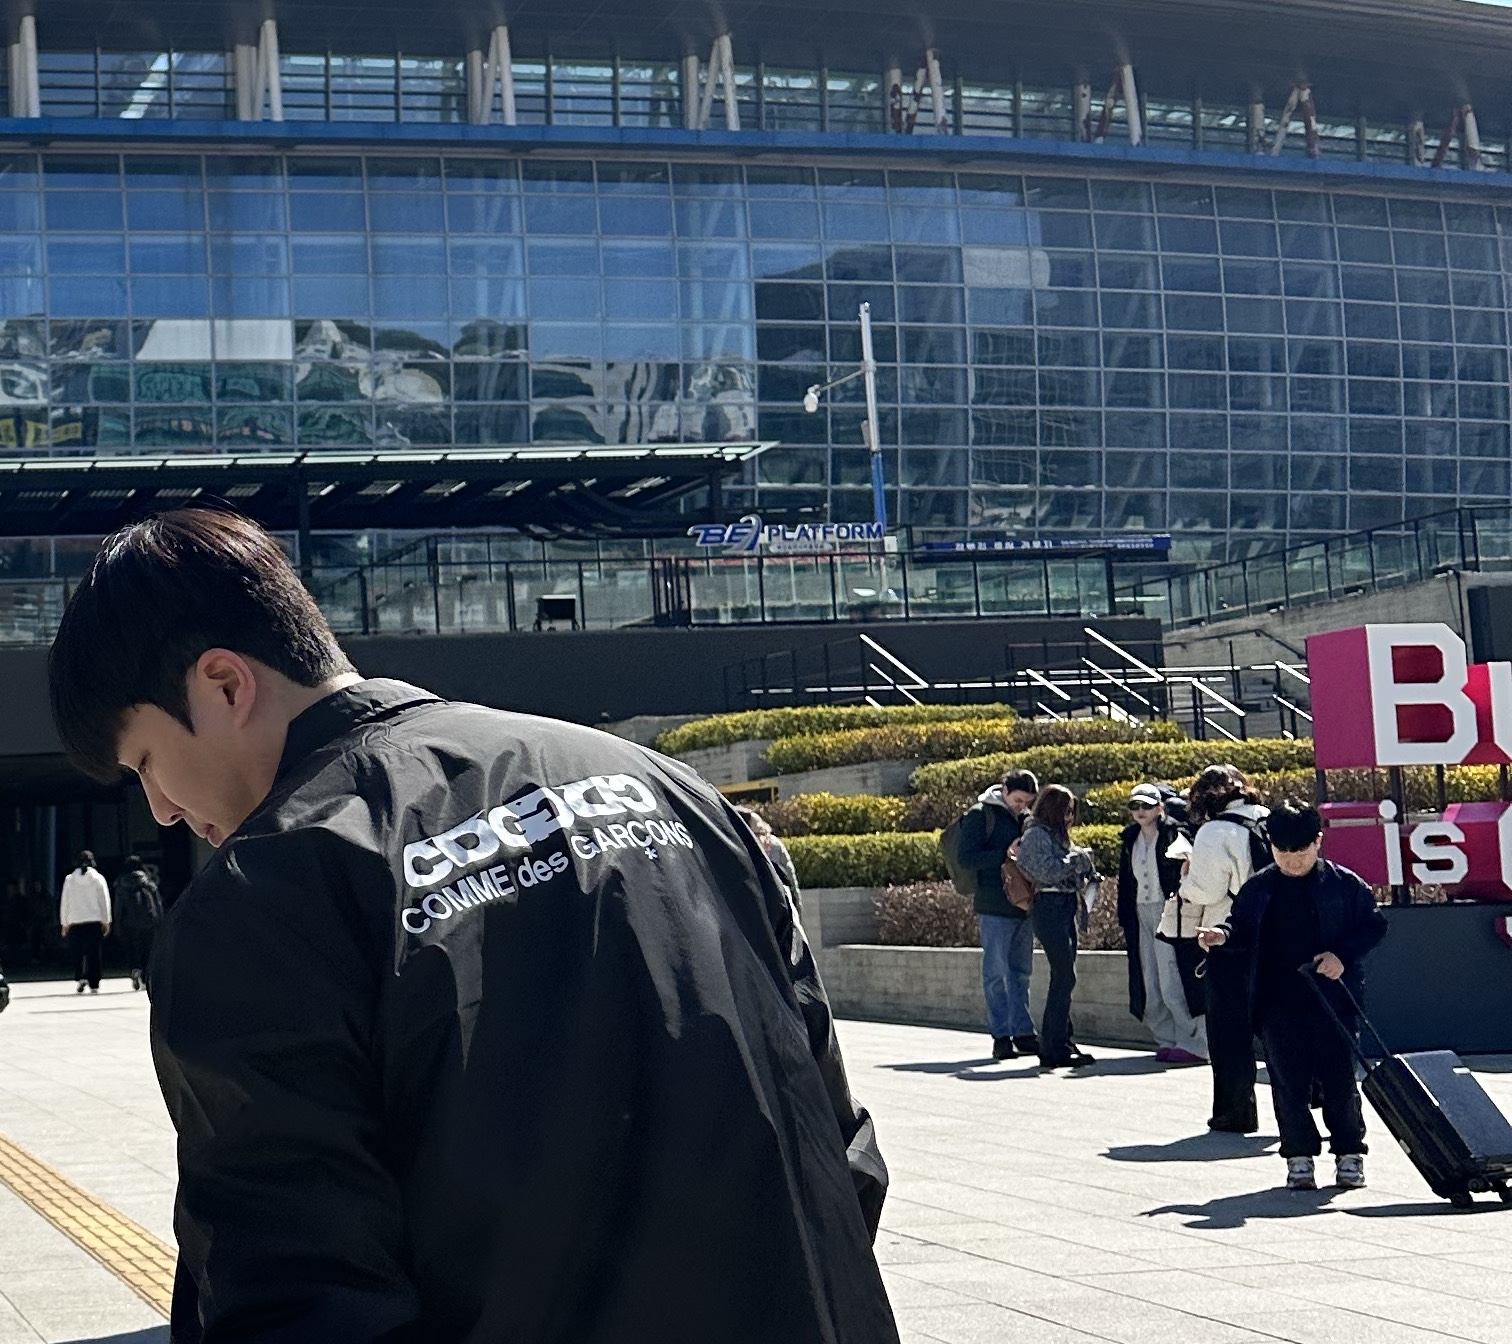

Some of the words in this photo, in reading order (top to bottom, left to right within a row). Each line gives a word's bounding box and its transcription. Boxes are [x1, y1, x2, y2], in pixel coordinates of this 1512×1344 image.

[765, 522, 884, 541] PLATFORM
[1366, 622, 1512, 766] B
[1378, 799, 1470, 886] is
[401, 864, 515, 934] COMME
[517, 849, 569, 888] des
